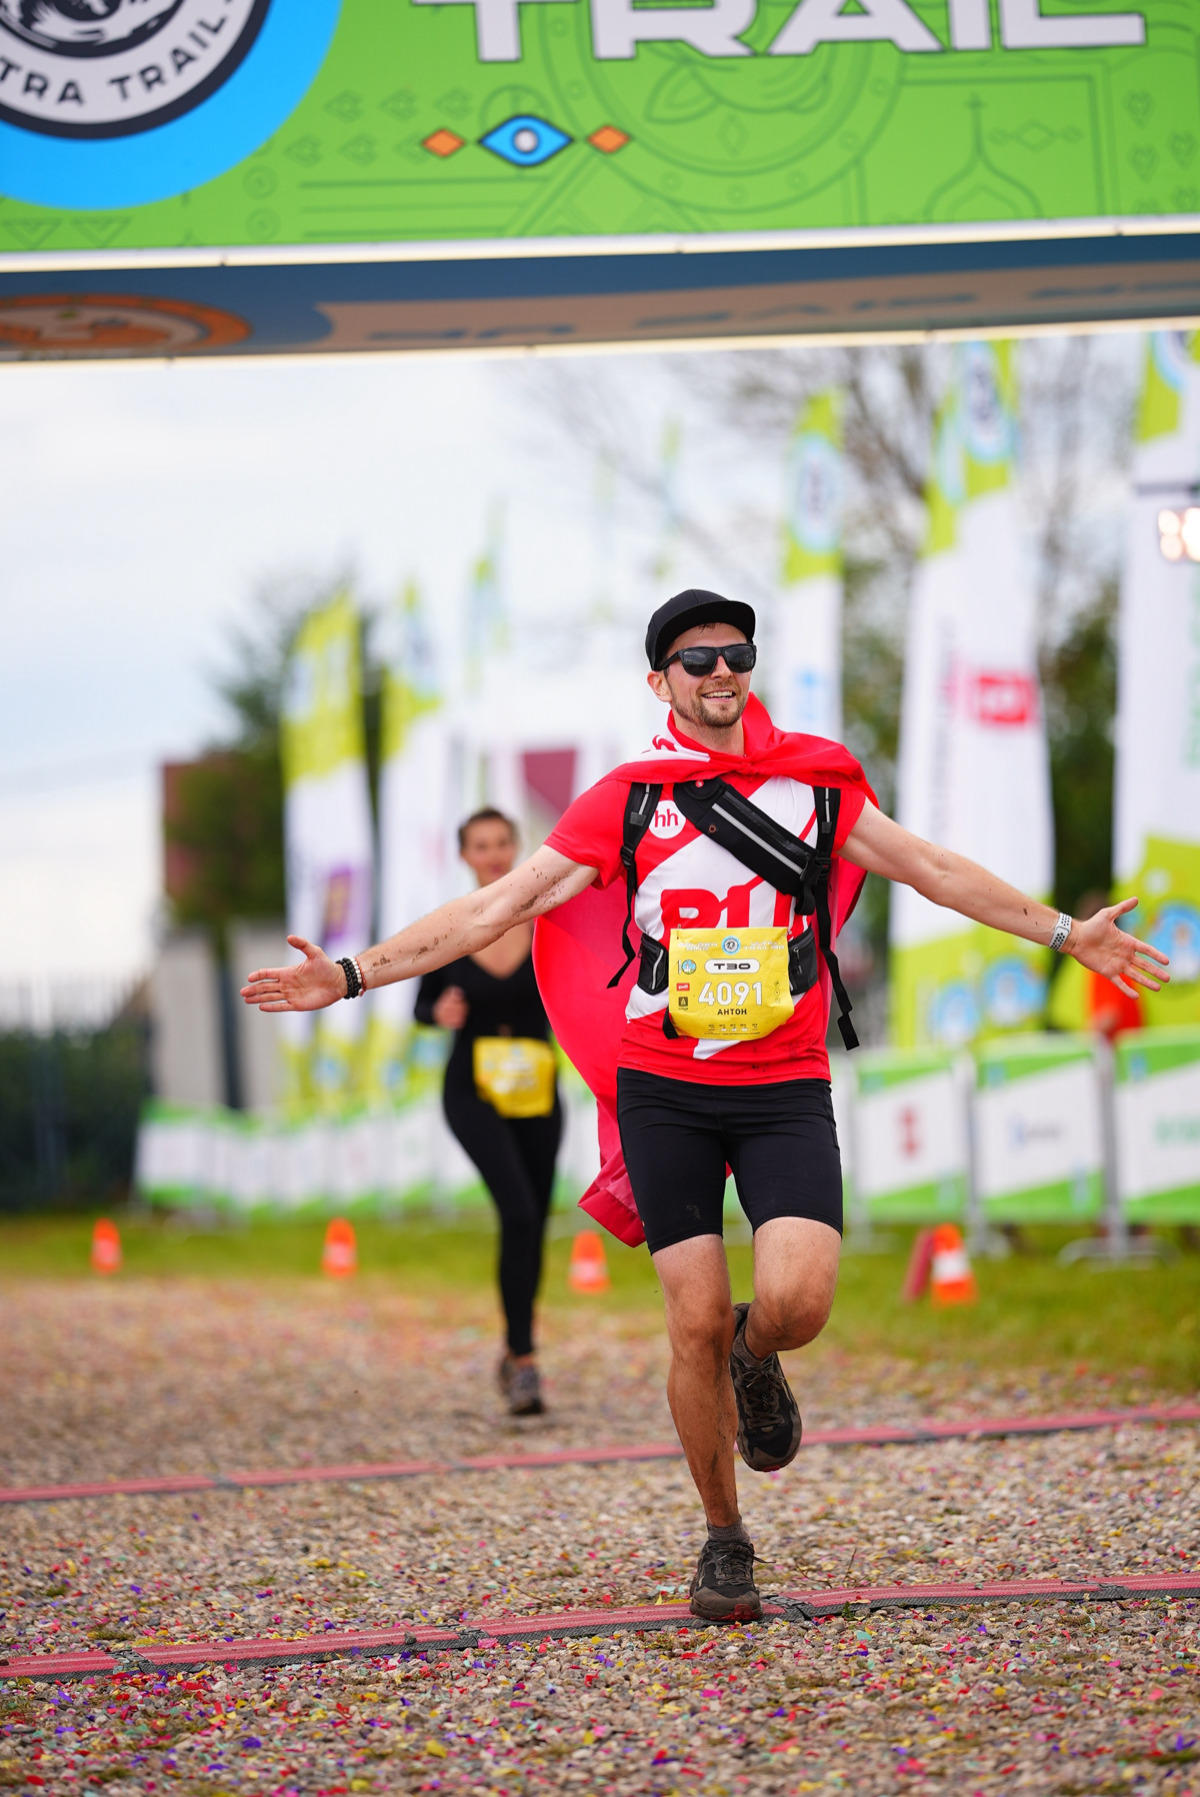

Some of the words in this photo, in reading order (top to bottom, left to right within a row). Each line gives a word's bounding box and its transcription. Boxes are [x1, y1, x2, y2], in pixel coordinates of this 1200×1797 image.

[411, 0, 1147, 62] TRAIL
[0, 56, 86, 107] TRA
[107, 14, 229, 101] TRAIL
[654, 808, 679, 828] hh
[698, 981, 762, 1007] 4091
[717, 1008, 748, 1016] АНТОН
